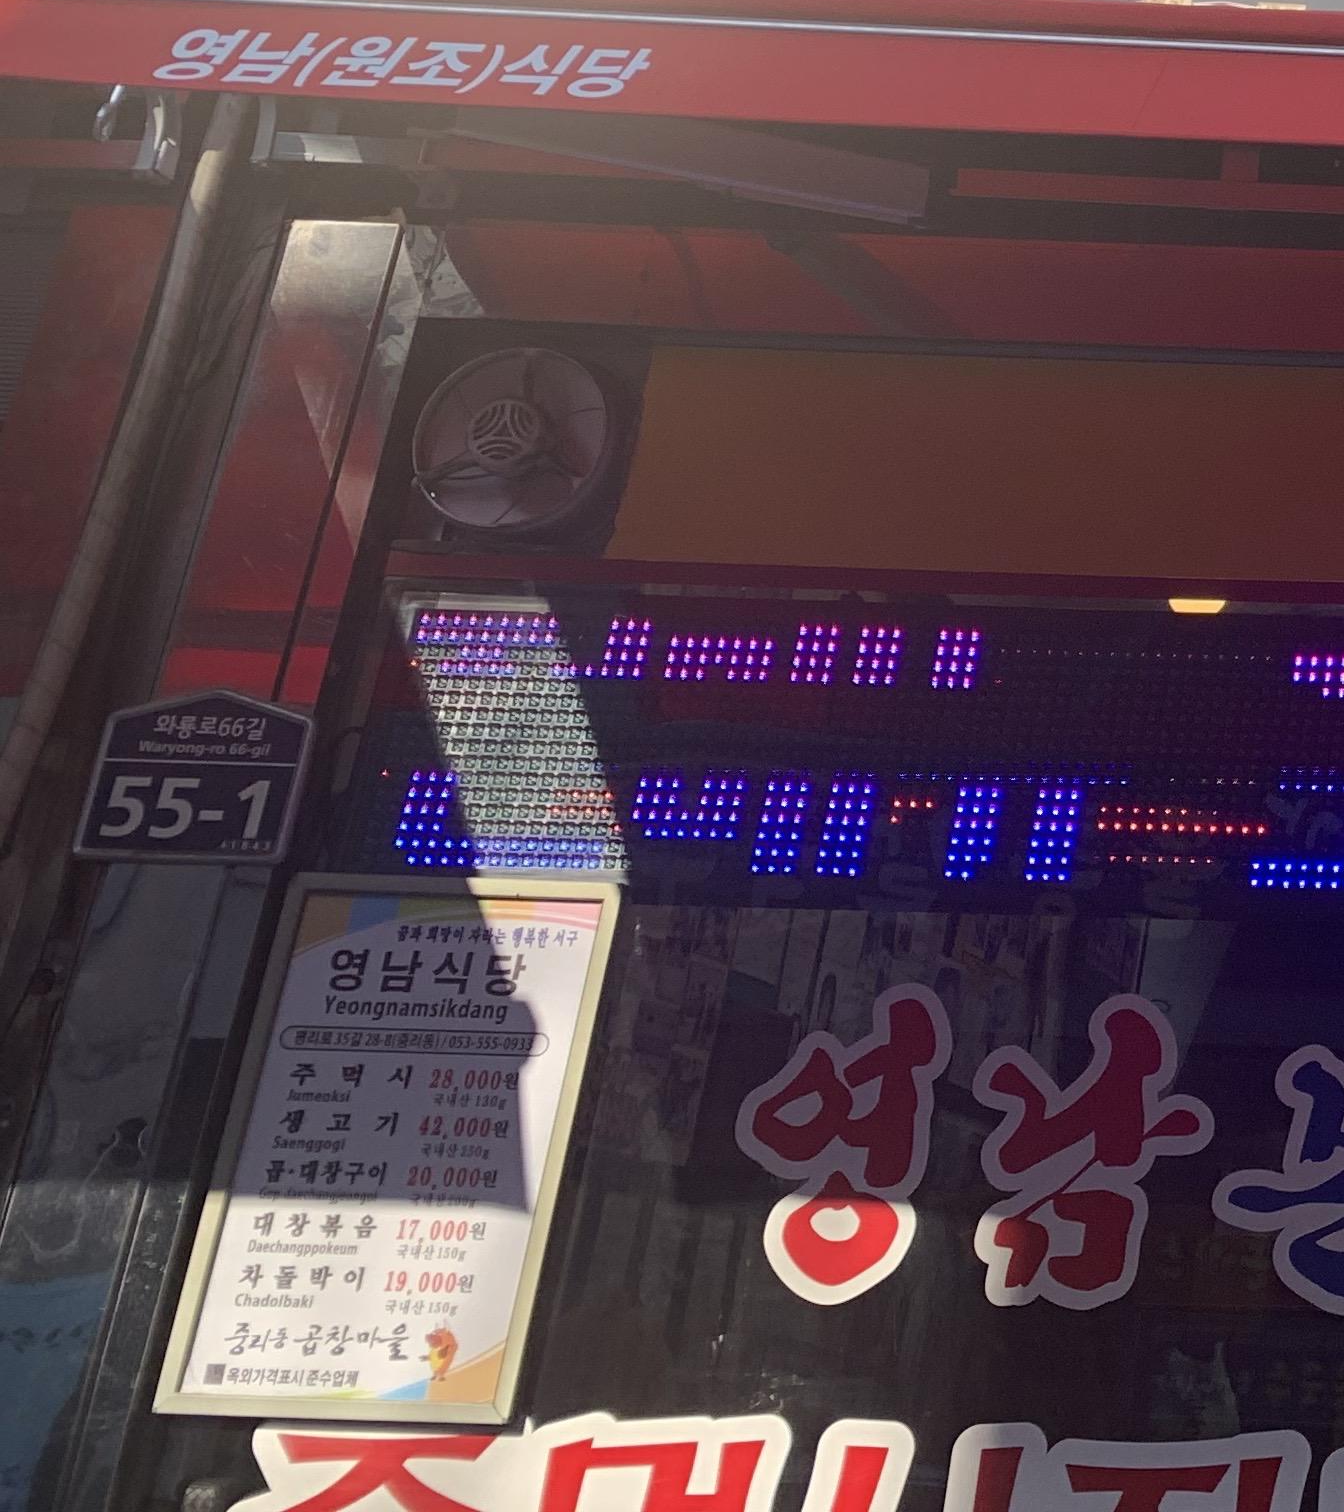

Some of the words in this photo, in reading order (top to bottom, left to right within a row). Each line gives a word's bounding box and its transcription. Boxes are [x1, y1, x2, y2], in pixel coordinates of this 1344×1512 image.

[152, 26, 653, 101] 영남(원조)식당
[153, 714, 266, 741] 와룡로66길
[138, 740, 226, 756] Waryong-ro
[229, 743, 271, 758] 66-gil
[99, 776, 272, 839] 55-1
[512, 928, 550, 949] 행복한
[553, 929, 579, 948] 서구
[329, 948, 527, 997] 영남식당
[324, 995, 508, 1024] Yeongnamsikdang
[429, 1068, 520, 1092] 28,000원
[419, 1114, 509, 1141] 42,000원
[407, 1165, 498, 1191] 20,000원
[396, 1218, 487, 1245] 17,000원
[247, 1238, 358, 1258] Daechangppokeum
[383, 1270, 475, 1296] 19,000원
[234, 1292, 315, 1310] Chadolbaki
